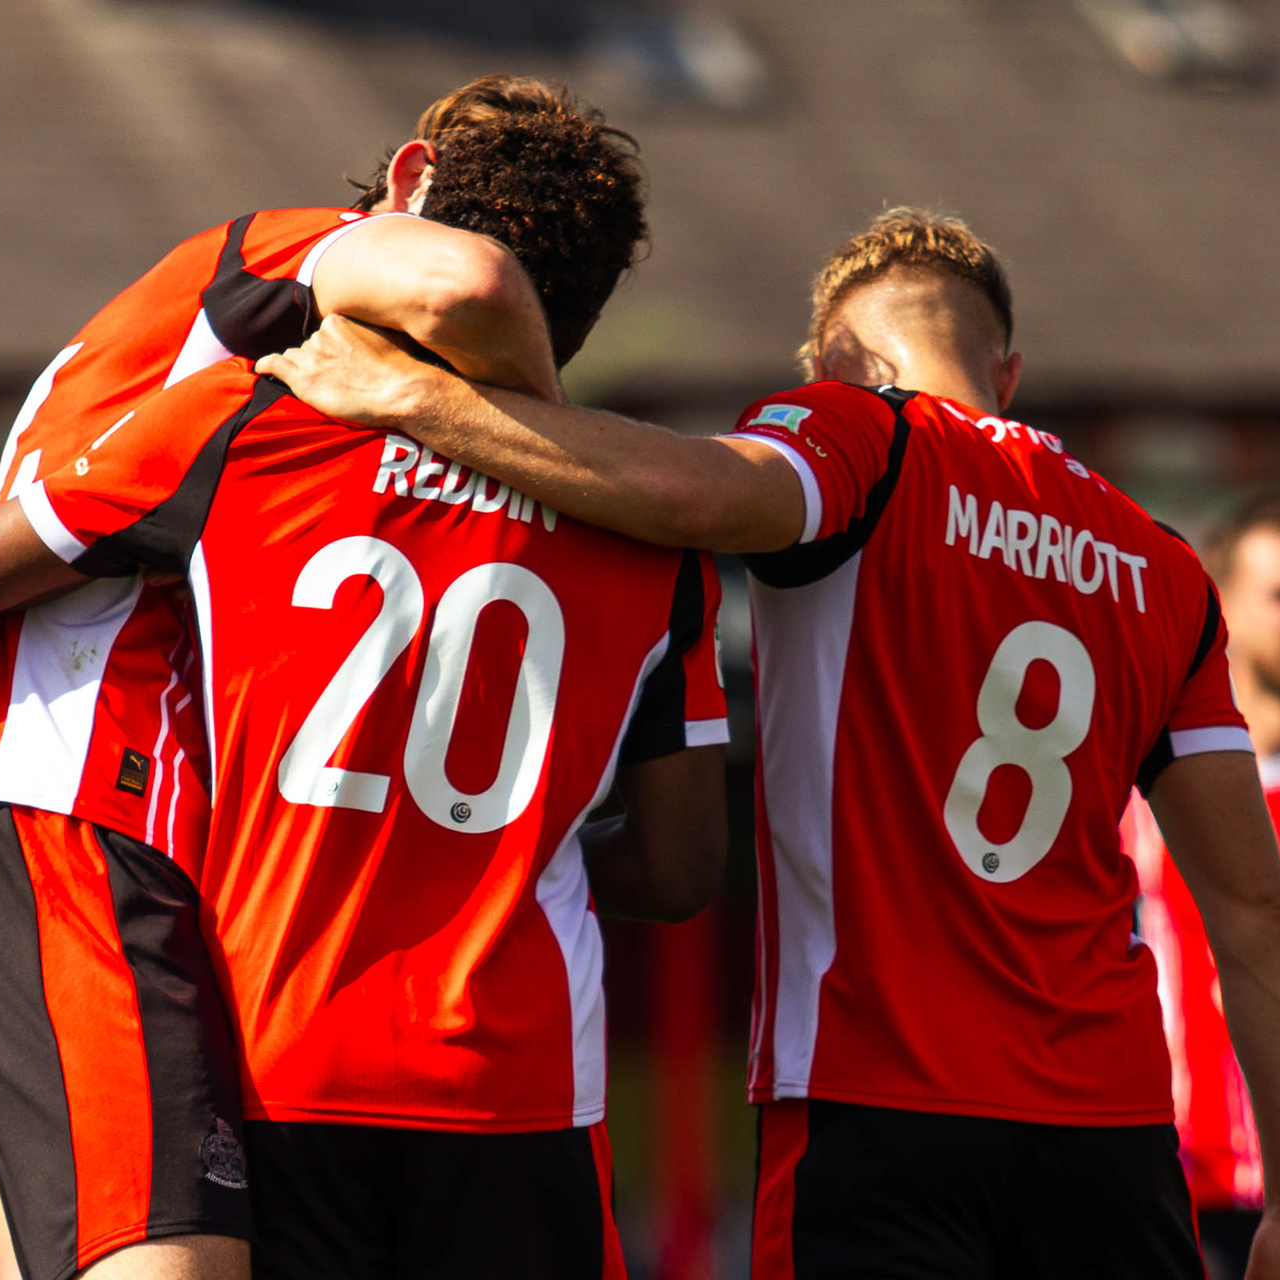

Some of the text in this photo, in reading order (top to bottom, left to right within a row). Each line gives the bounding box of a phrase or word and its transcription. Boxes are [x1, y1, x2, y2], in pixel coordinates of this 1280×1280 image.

[945, 484, 1148, 614] MARRIOTT
[278, 535, 566, 834] 20
[943, 619, 1096, 883] 8
